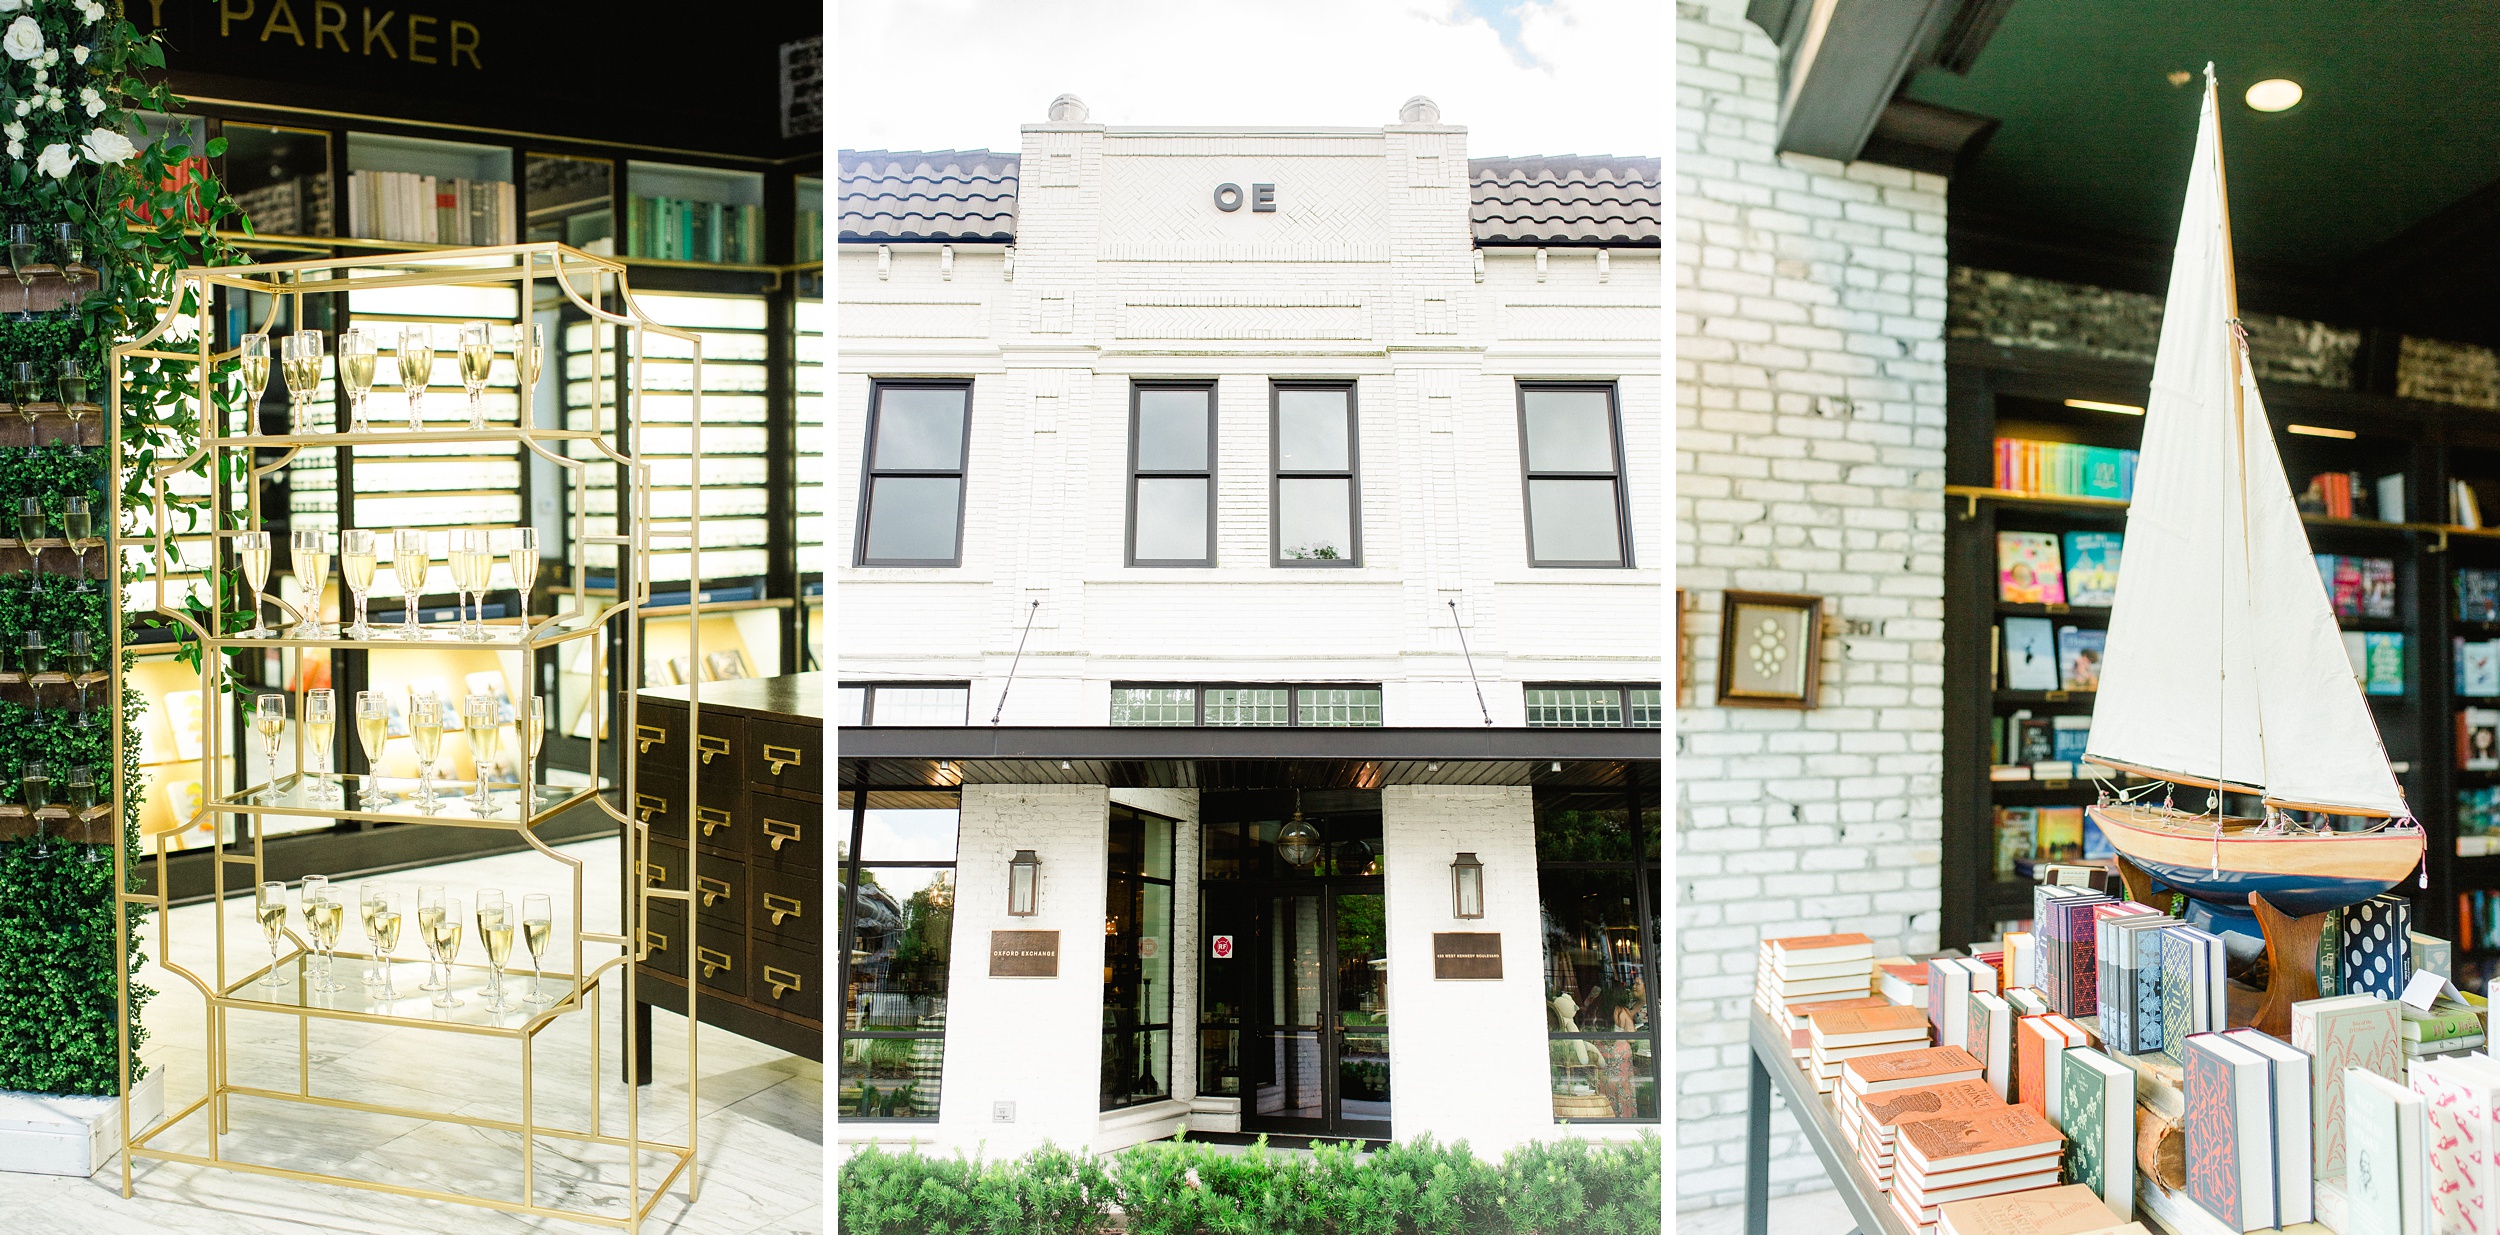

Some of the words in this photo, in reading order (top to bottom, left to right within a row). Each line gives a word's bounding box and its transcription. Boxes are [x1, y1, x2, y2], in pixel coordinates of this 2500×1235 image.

[220, 0, 482, 69] PARKER
[1213, 182, 1277, 213] OE
[1961, 1084, 1992, 1108] PRINCE
